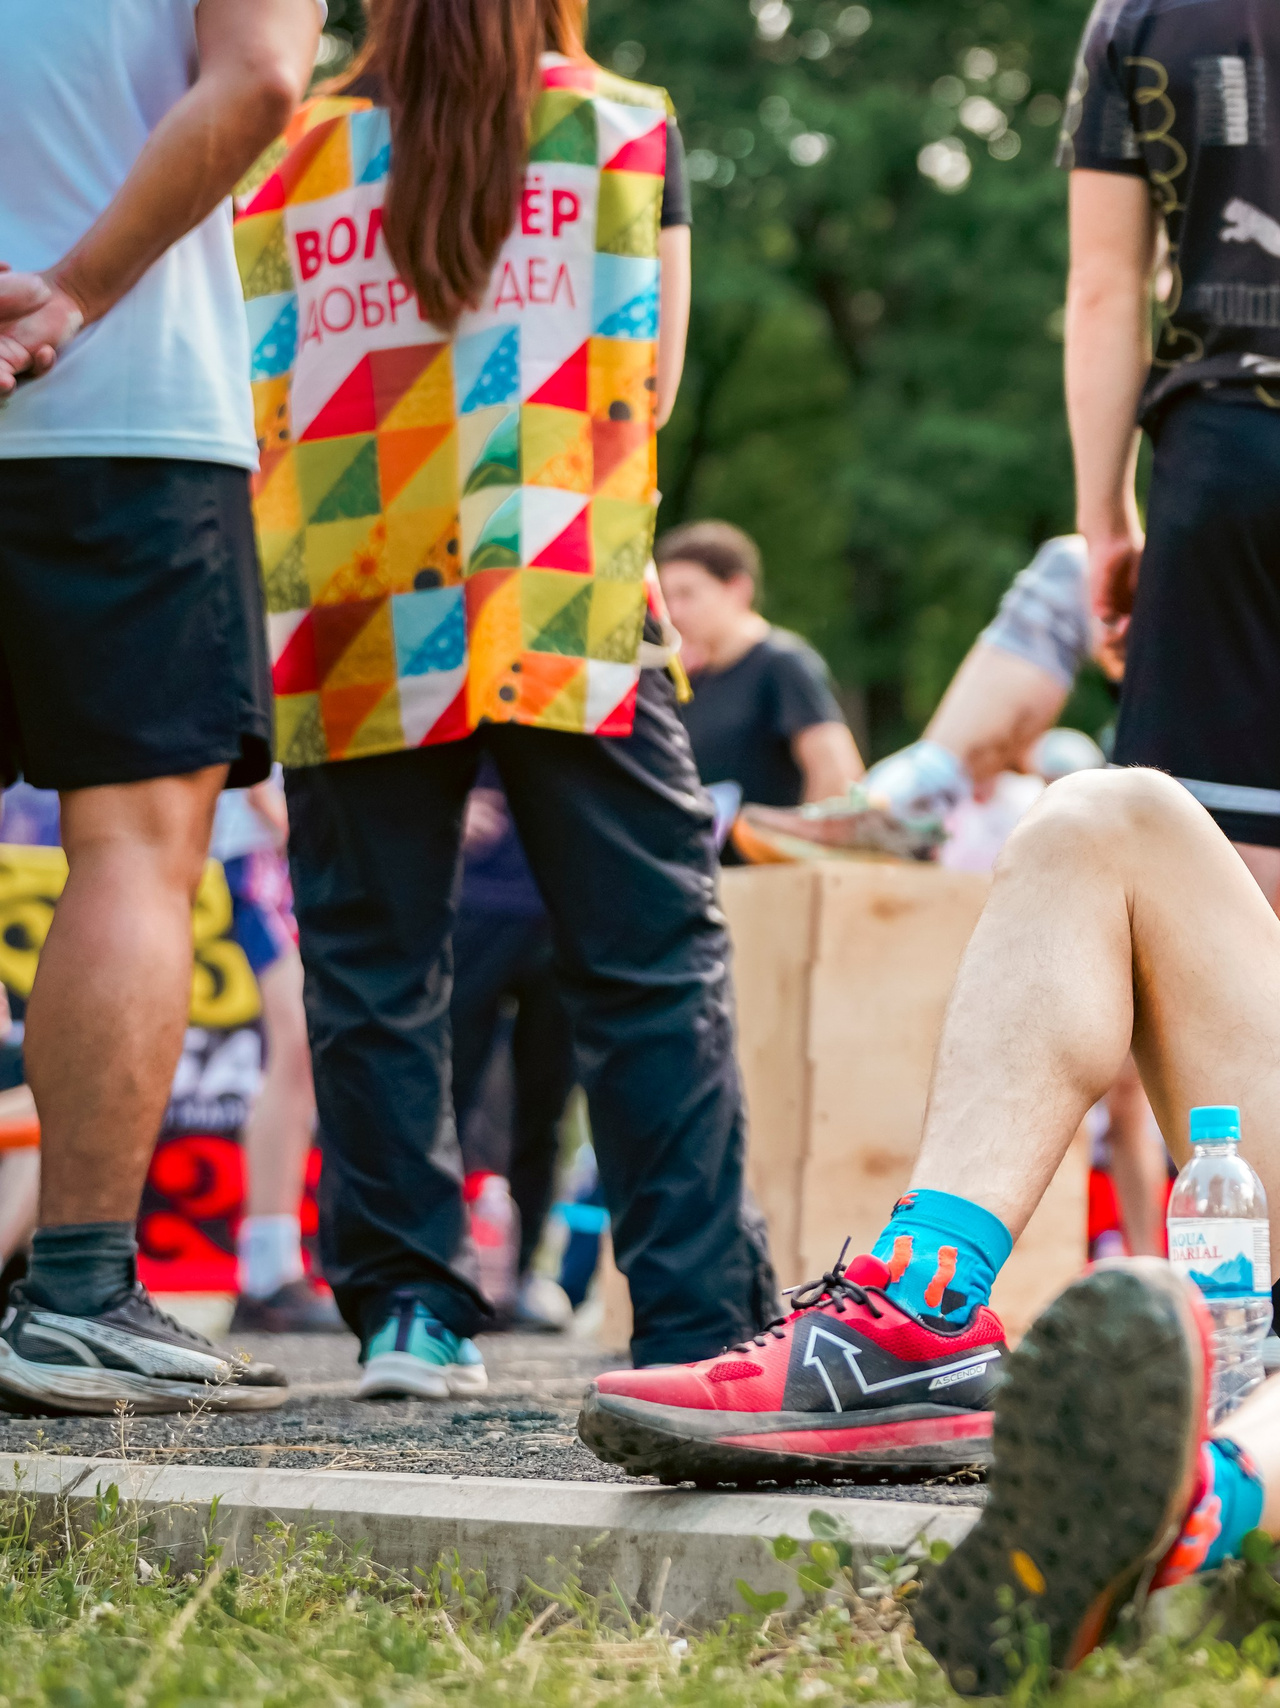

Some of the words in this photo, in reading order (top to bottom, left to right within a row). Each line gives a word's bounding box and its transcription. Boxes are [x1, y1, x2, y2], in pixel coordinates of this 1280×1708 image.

[295, 176, 580, 281] ВОЛЁР
[302, 277, 478, 345] ДОБР
[495, 258, 576, 309] ДЕЛ
[1173, 1245, 1222, 1261] DARIAL
[934, 1365, 983, 1387] ASCENDO
